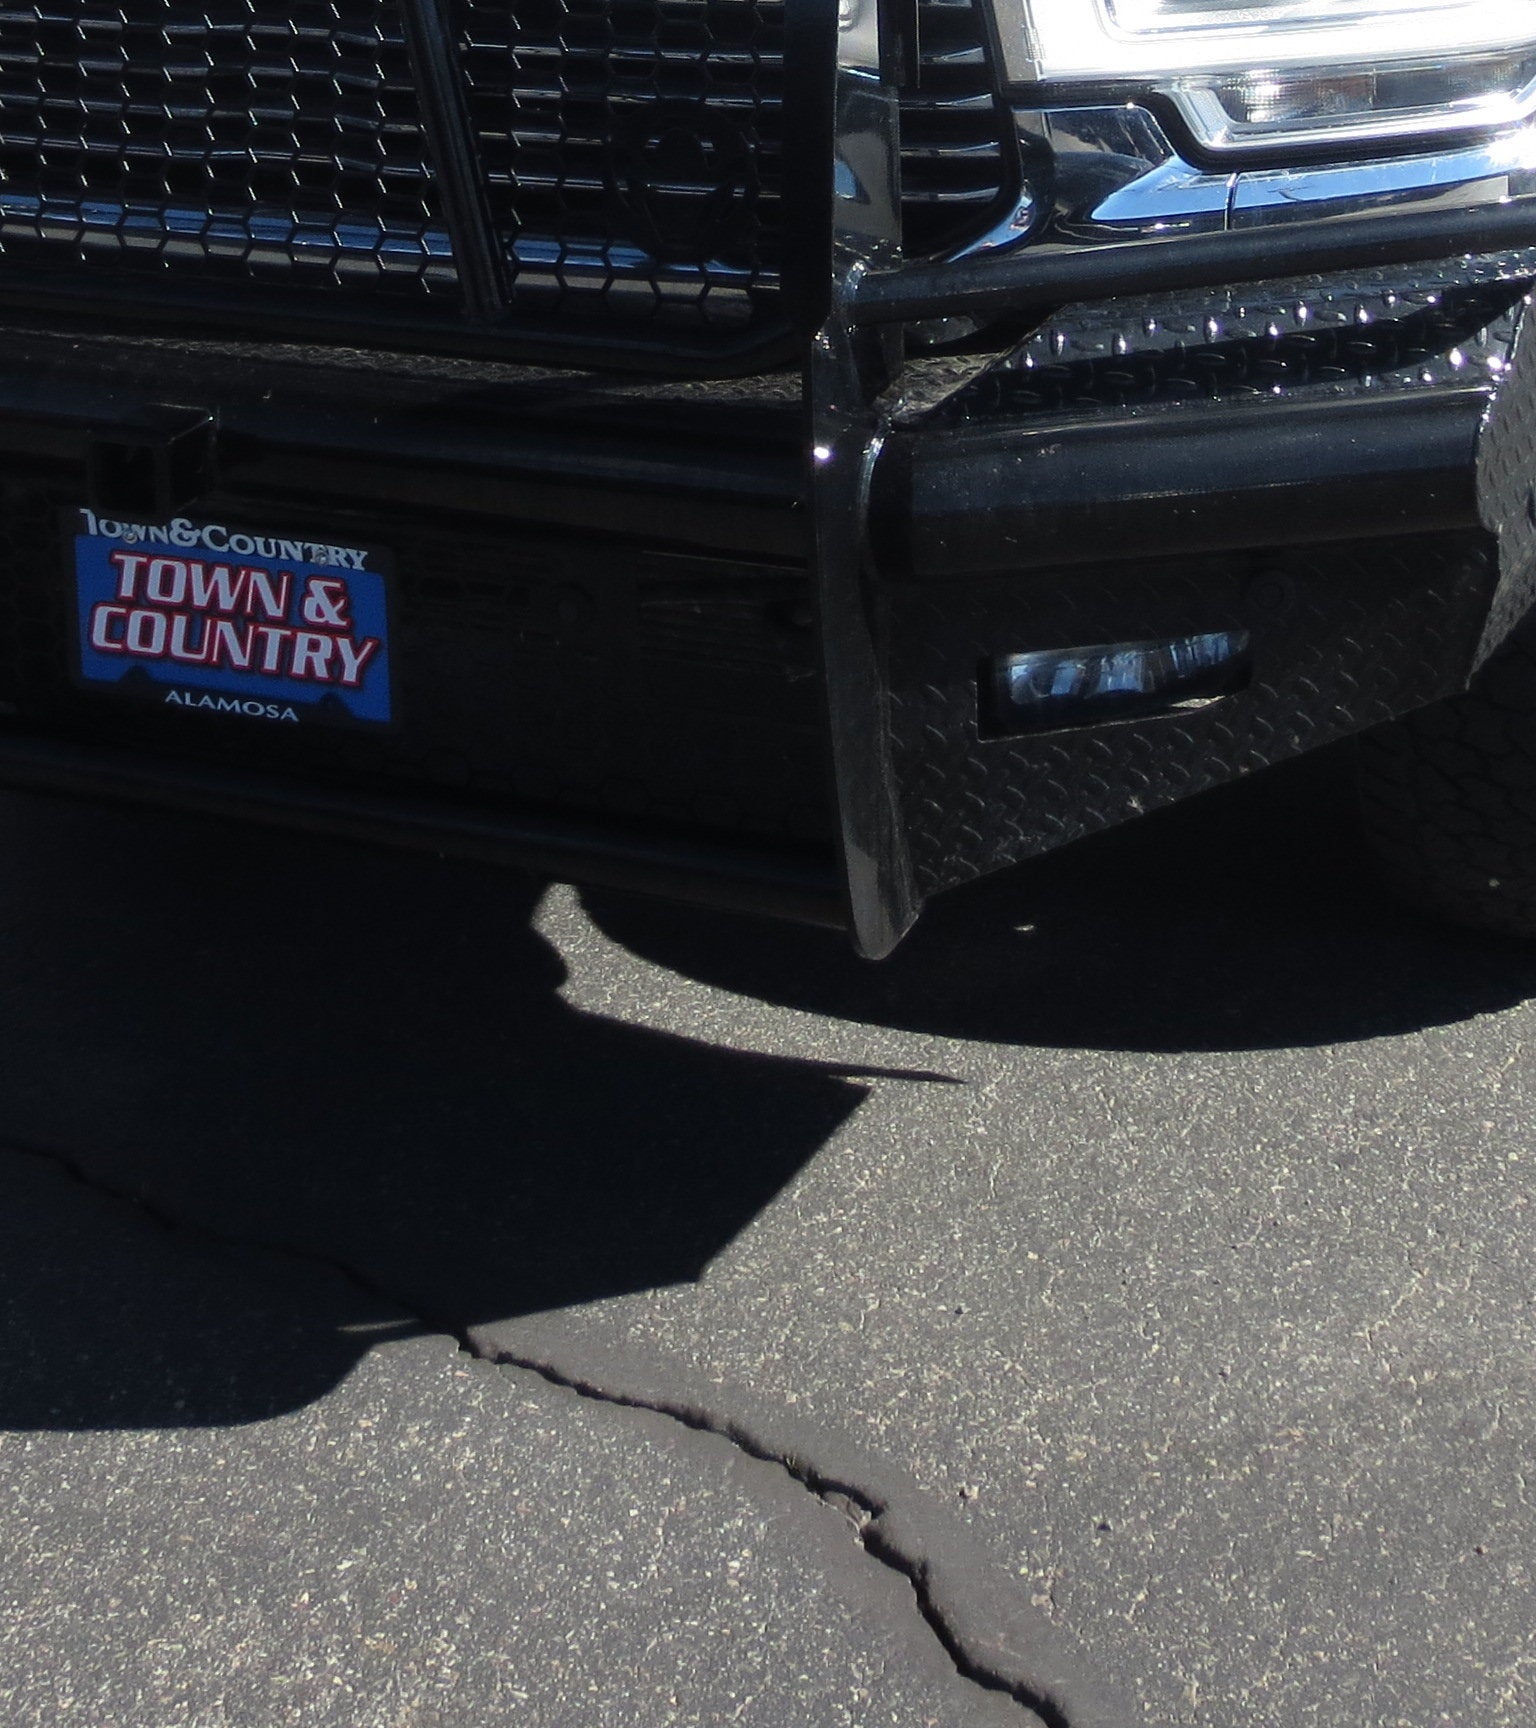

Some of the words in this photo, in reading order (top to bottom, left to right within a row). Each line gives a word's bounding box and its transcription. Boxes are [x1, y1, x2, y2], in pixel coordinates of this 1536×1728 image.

[112, 552, 290, 620] TOWN
[302, 578, 349, 627] &
[91, 604, 375, 684] COUNTRY
[165, 689, 300, 722] ALAMOSA
